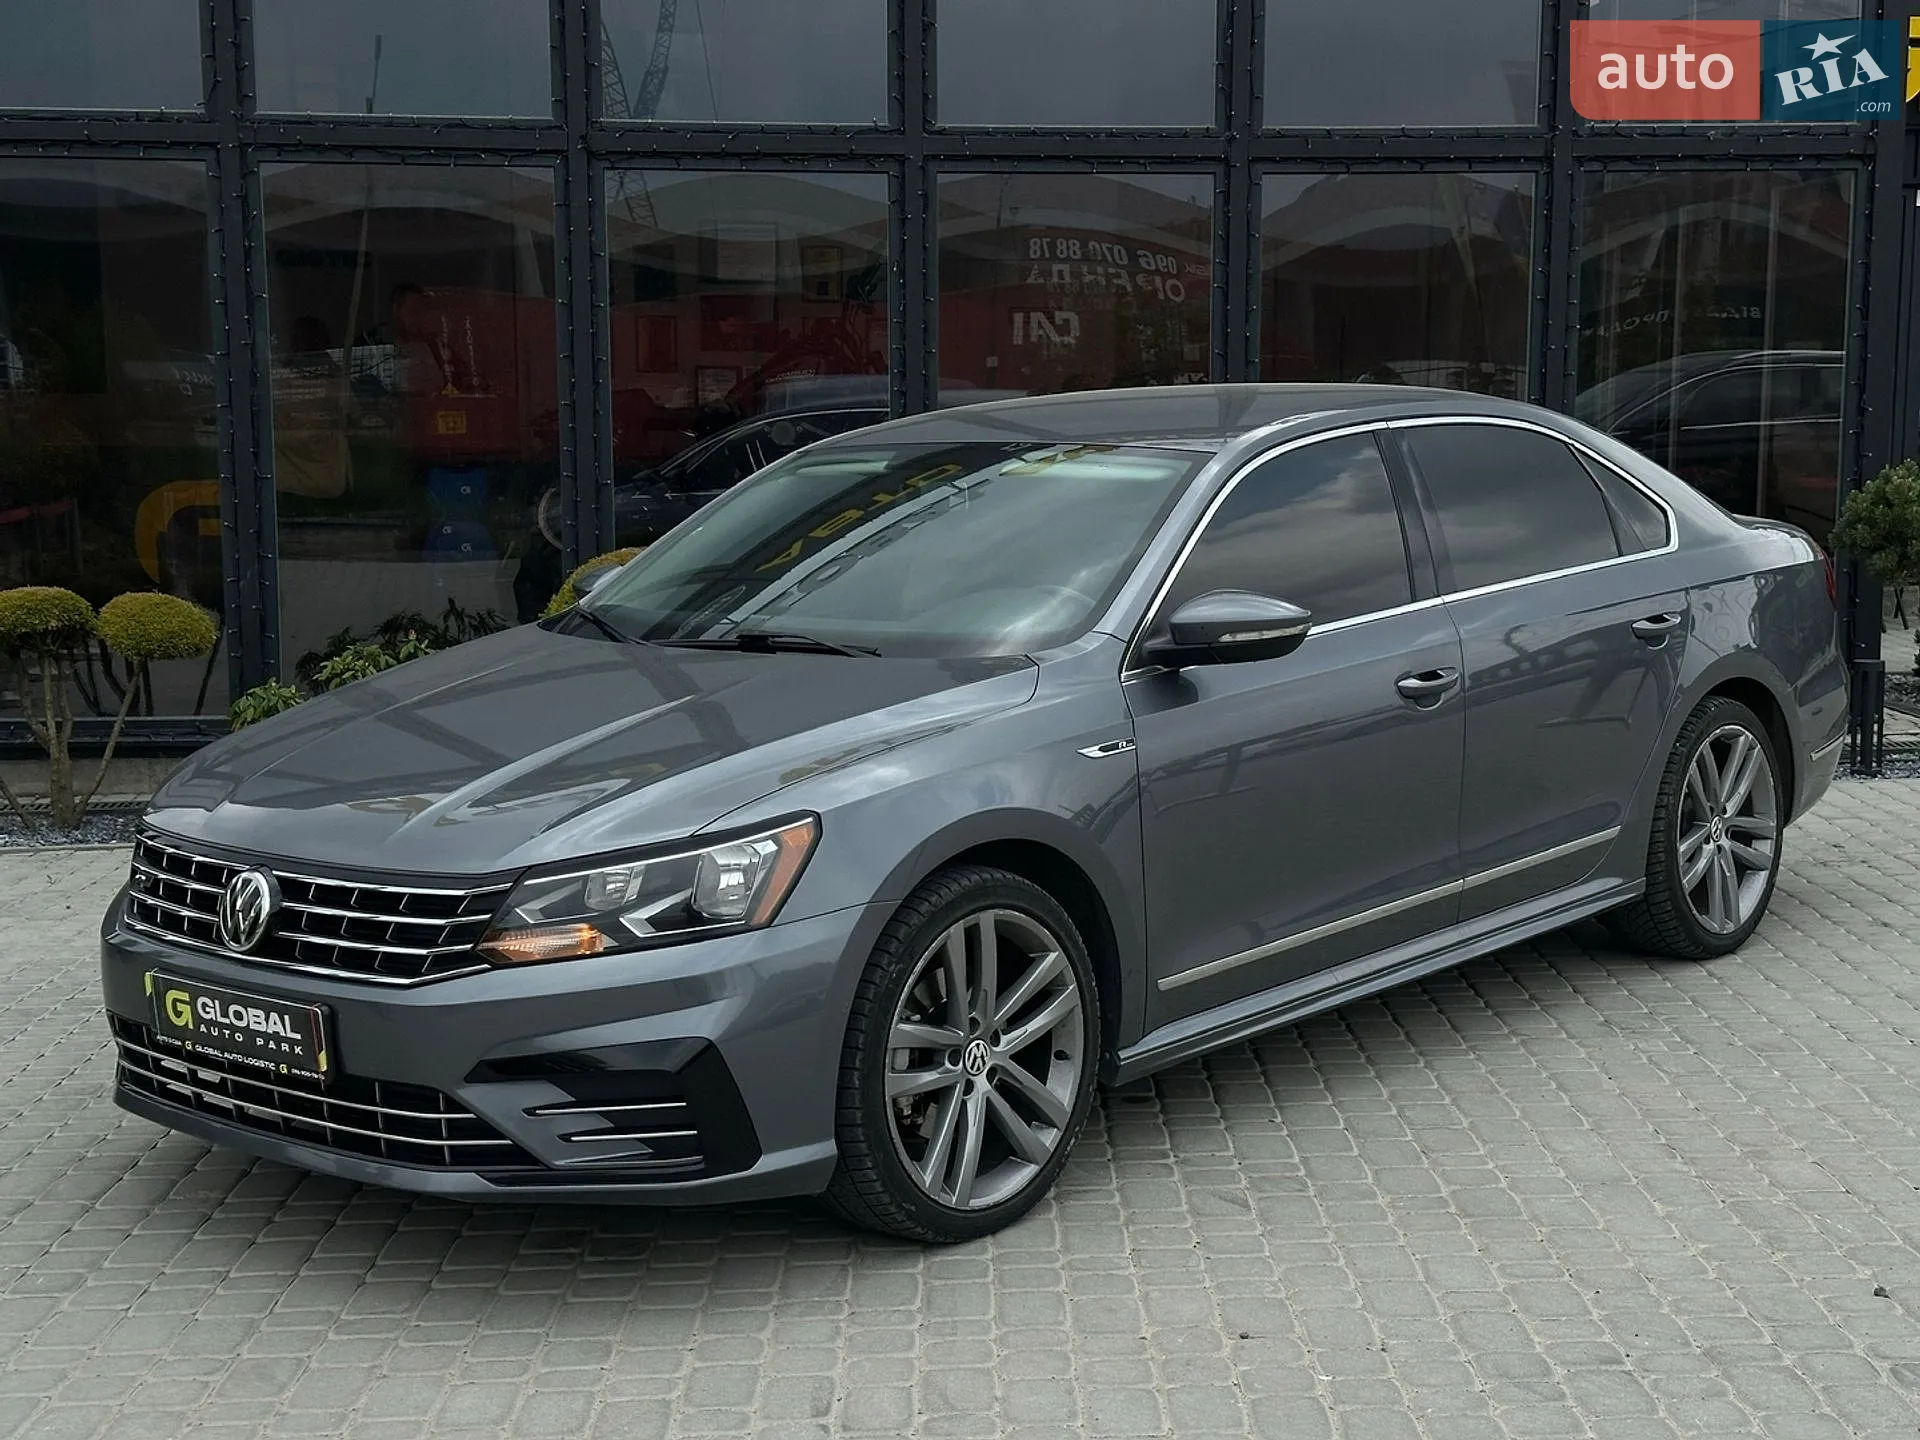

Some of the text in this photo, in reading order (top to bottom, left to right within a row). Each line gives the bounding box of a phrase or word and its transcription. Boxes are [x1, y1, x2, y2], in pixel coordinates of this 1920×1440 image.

[196, 996, 302, 1040] GLOBAL
[195, 1044, 223, 1057] GLOBAL
[199, 1024, 244, 1042] AUTO
[256, 1038, 304, 1056] PARK
